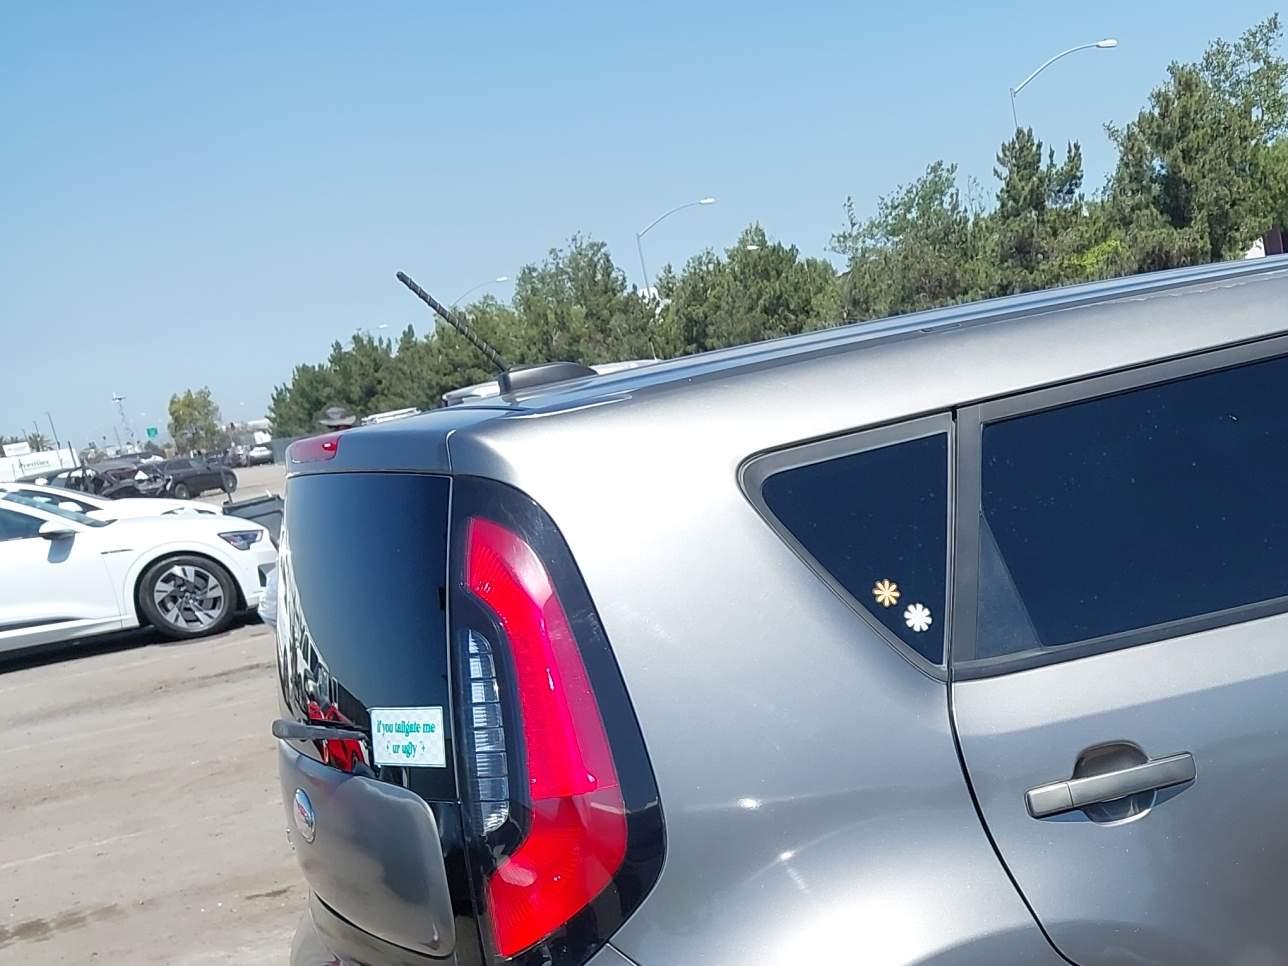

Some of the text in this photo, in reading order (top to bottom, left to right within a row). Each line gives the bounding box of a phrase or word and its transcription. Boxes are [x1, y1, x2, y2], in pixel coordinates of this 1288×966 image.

[382, 723, 393, 736] you
[395, 721, 421, 737] tailgate
[423, 723, 436, 733] me
[392, 741, 417, 758] ur ugly
